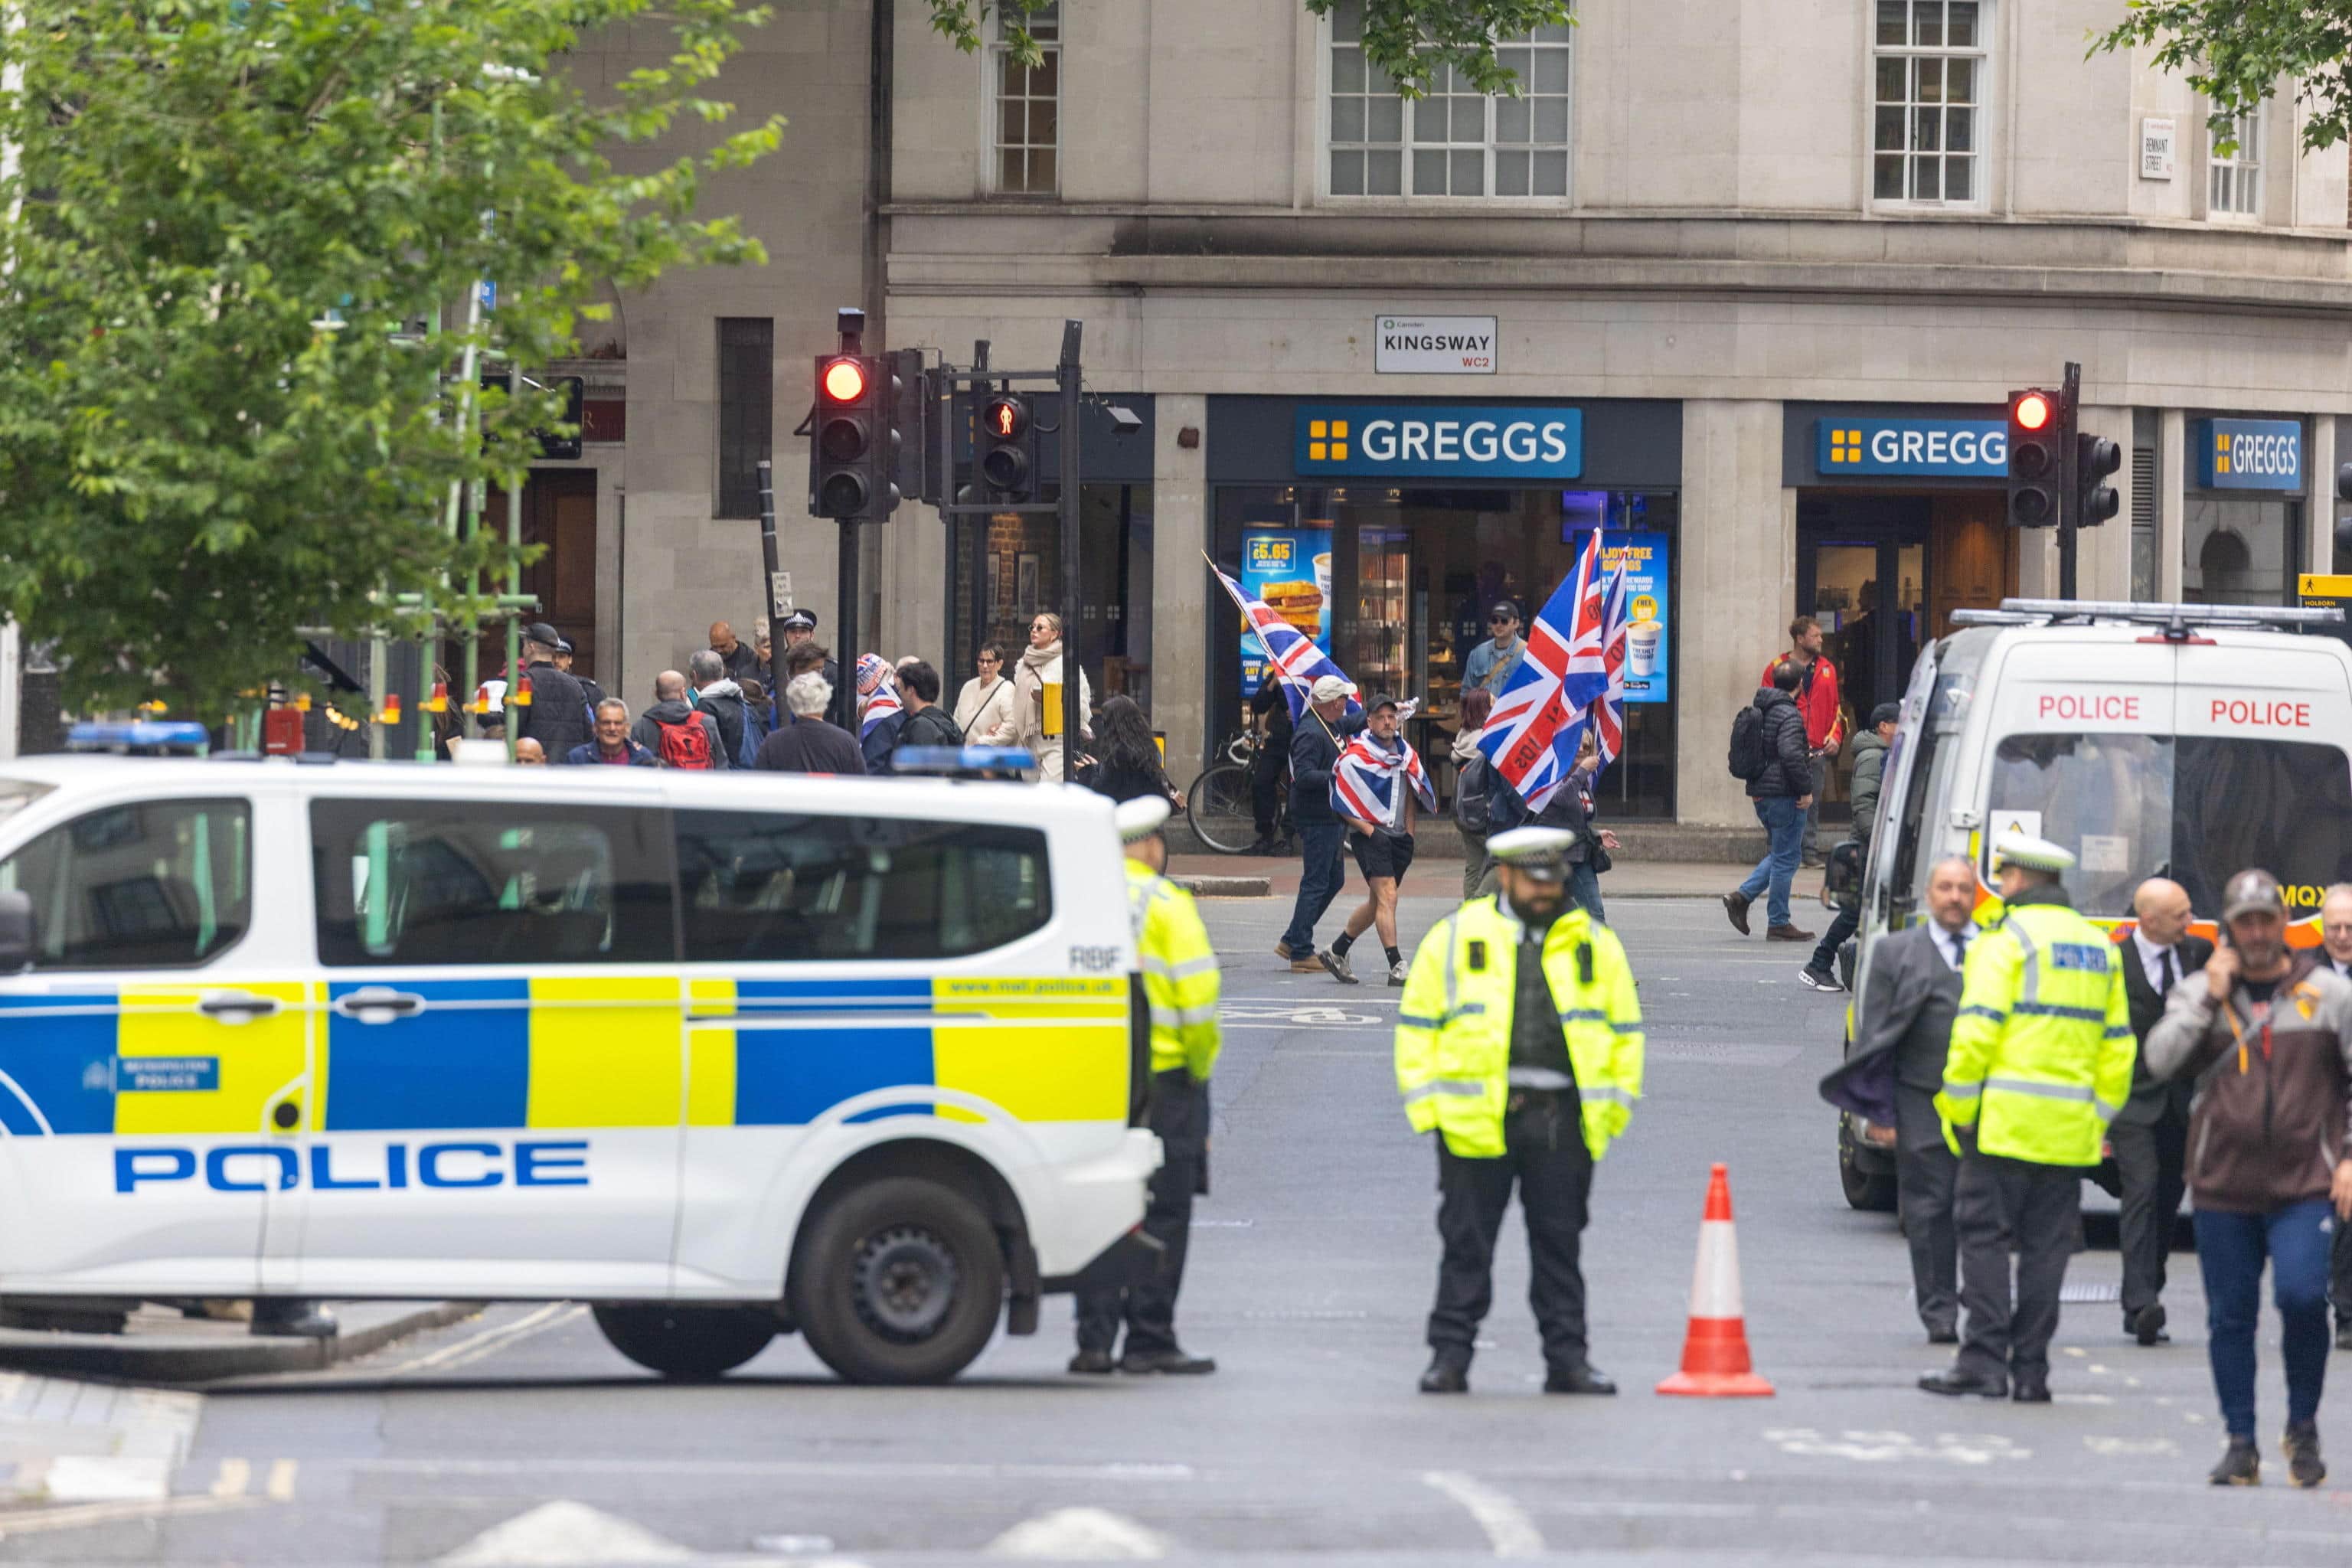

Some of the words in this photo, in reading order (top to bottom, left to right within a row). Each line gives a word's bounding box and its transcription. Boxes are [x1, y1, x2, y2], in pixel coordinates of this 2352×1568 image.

[2145, 138, 2168, 153] REMNANT
[2145, 155, 2162, 171] STREET
[1384, 335, 1490, 351] KINGSWAY
[1462, 357, 1489, 368] WC2
[1362, 420, 1567, 463] GREGGS
[1871, 429, 2007, 465] GREGG
[2233, 433, 2296, 475] GREGGS
[2040, 695, 2140, 720] POLICE
[2211, 700, 2311, 727] POLICE
[1070, 946, 1121, 971] RBF
[134, 1074, 198, 1088] POLICE
[114, 1141, 590, 1194] POLICE
